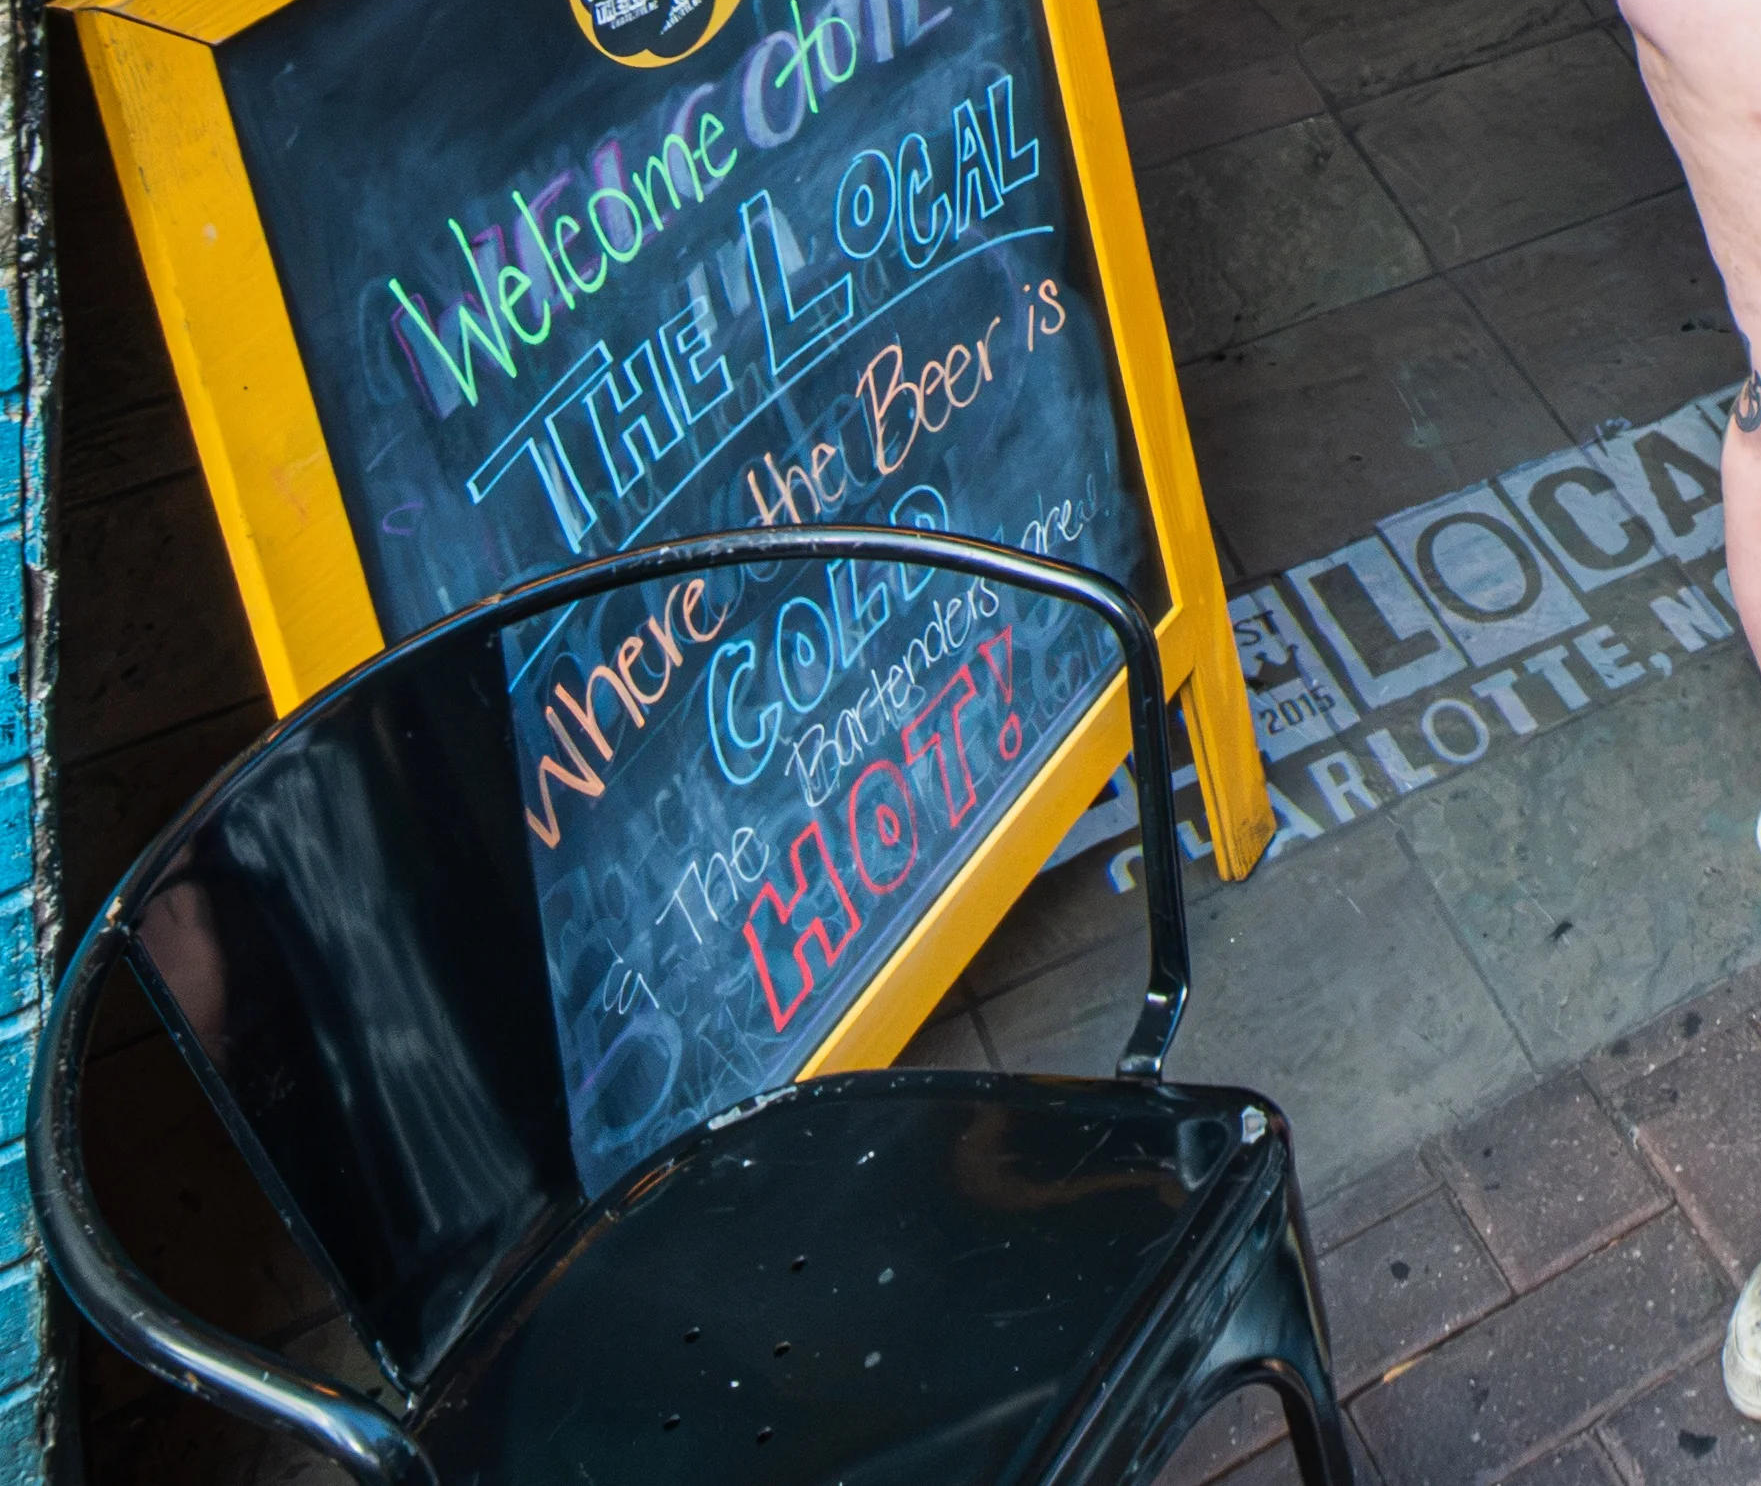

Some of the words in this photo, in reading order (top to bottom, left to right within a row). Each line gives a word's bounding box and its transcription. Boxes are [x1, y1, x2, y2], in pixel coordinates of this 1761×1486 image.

[389, 111, 738, 407] Welcome
[466, 295, 734, 554] THE
[740, 74, 1039, 377] LOCAL
[747, 444, 846, 525] the
[855, 316, 1001, 475] Beer
[1022, 278, 1066, 350] is
[706, 485, 949, 786] COLD
[1305, 398, 1740, 701] LOCA
[655, 826, 770, 945] The
[785, 576, 1000, 807] Bartenders
[742, 624, 1023, 1033] HOT!
[1259, 684, 1337, 737] 2015
